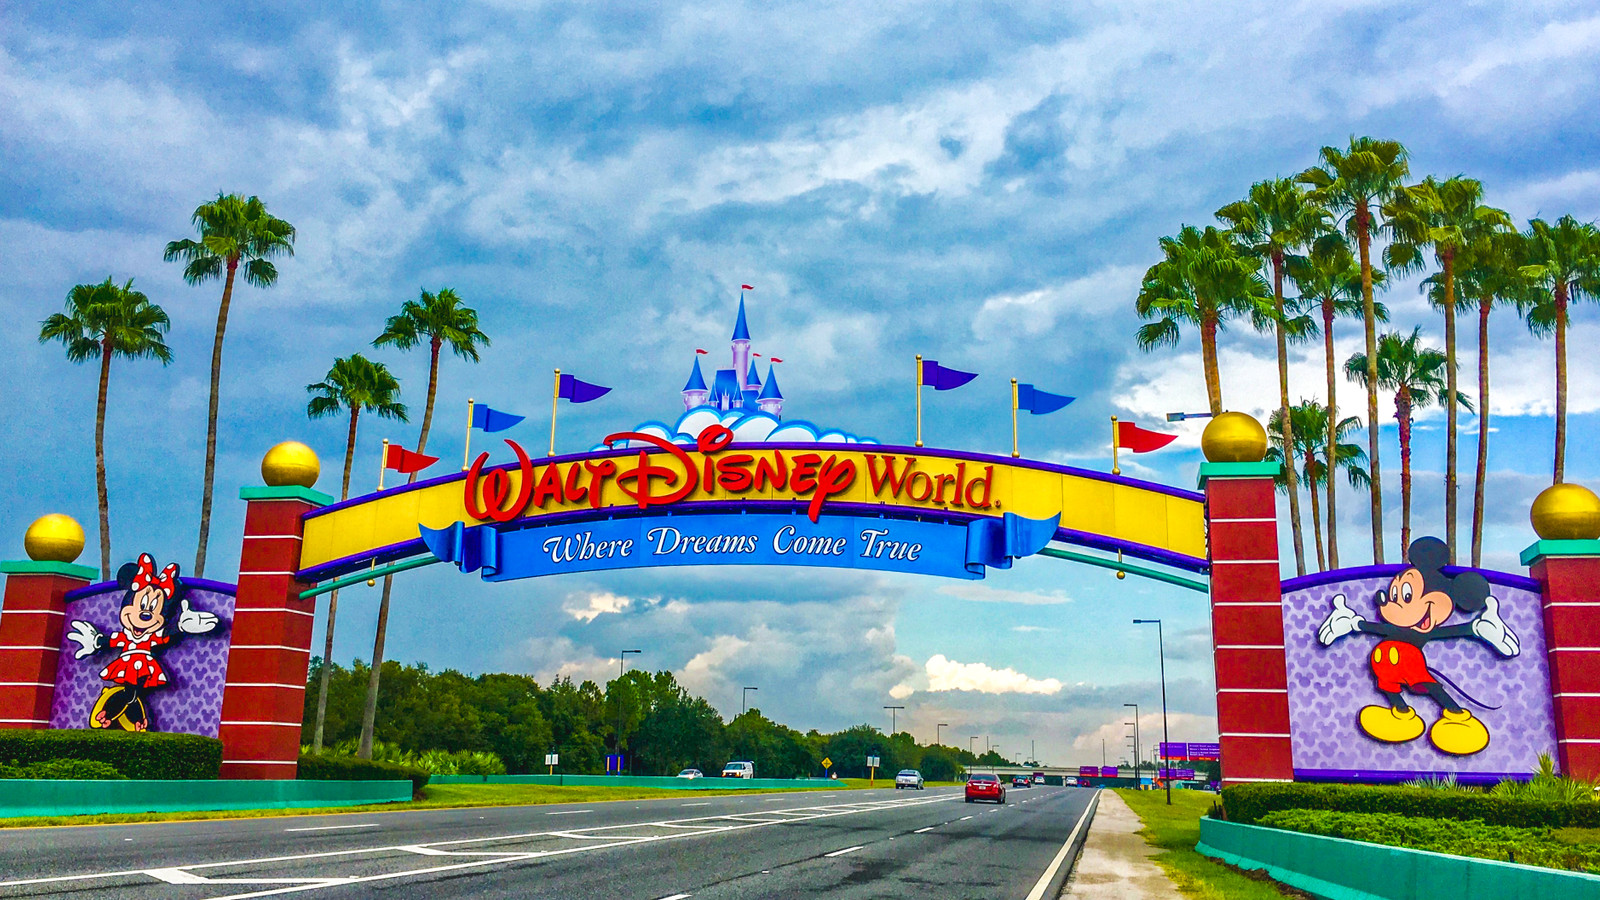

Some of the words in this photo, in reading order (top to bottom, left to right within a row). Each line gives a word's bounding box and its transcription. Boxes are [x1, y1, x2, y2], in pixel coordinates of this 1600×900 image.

[542, 531, 634, 563] Where
[646, 527, 759, 555] Dreams
[772, 525, 847, 555] Come
[860, 528, 922, 561] True
